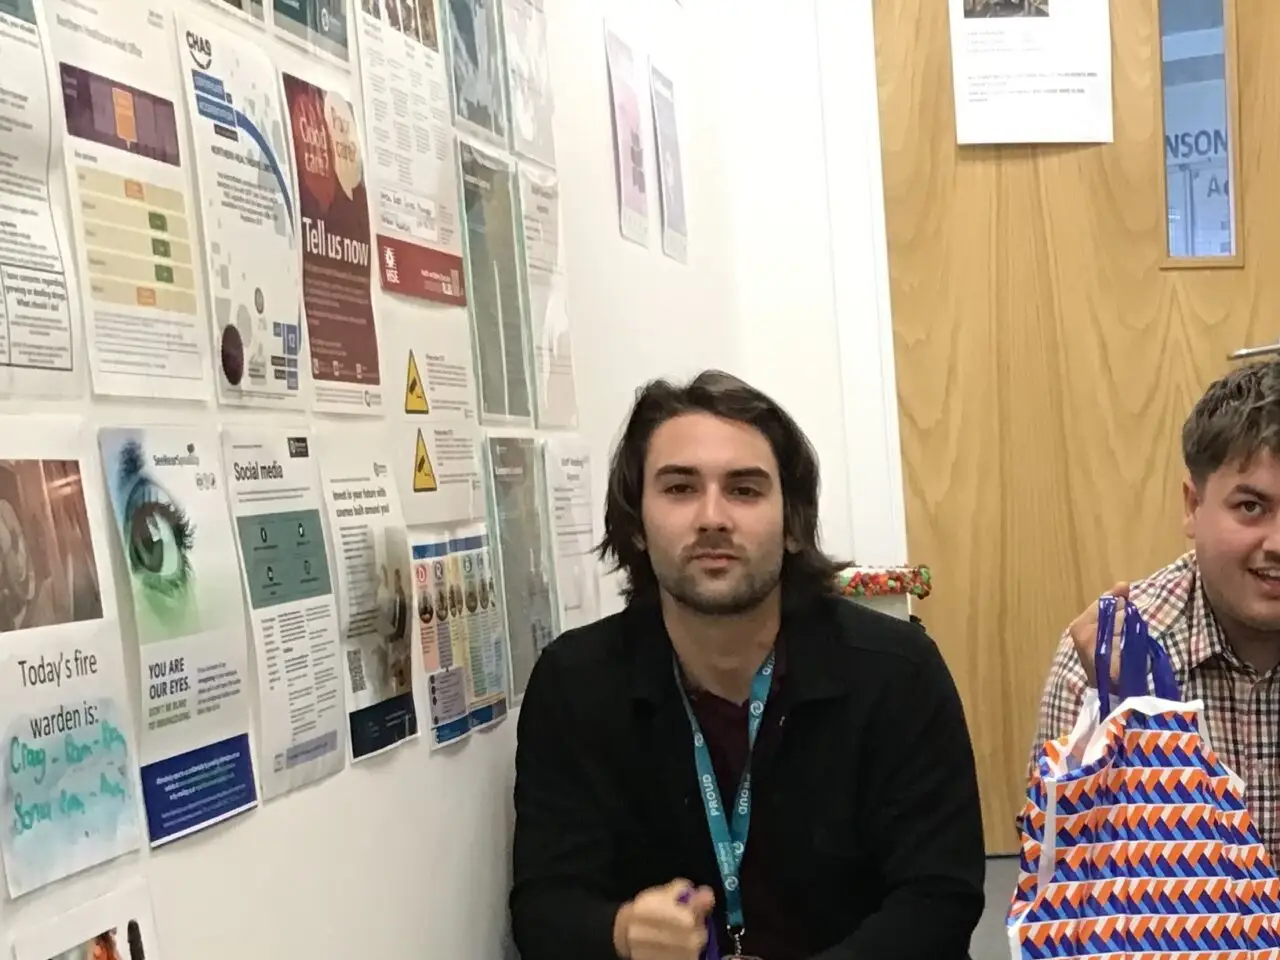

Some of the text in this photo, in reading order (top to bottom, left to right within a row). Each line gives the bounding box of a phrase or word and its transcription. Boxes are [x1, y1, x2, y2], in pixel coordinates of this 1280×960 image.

[186, 30, 212, 58] CHAS
[1165, 128, 1228, 159] NSON
[303, 216, 369, 267] Tell us now
[233, 460, 284, 481] Social media
[18, 649, 98, 688] Today's fire
[149, 657, 185, 681] YOU ARE
[149, 676, 191, 700] OUR EYES.
[30, 700, 99, 740] warden is:
[702, 773, 720, 817] PROUD
